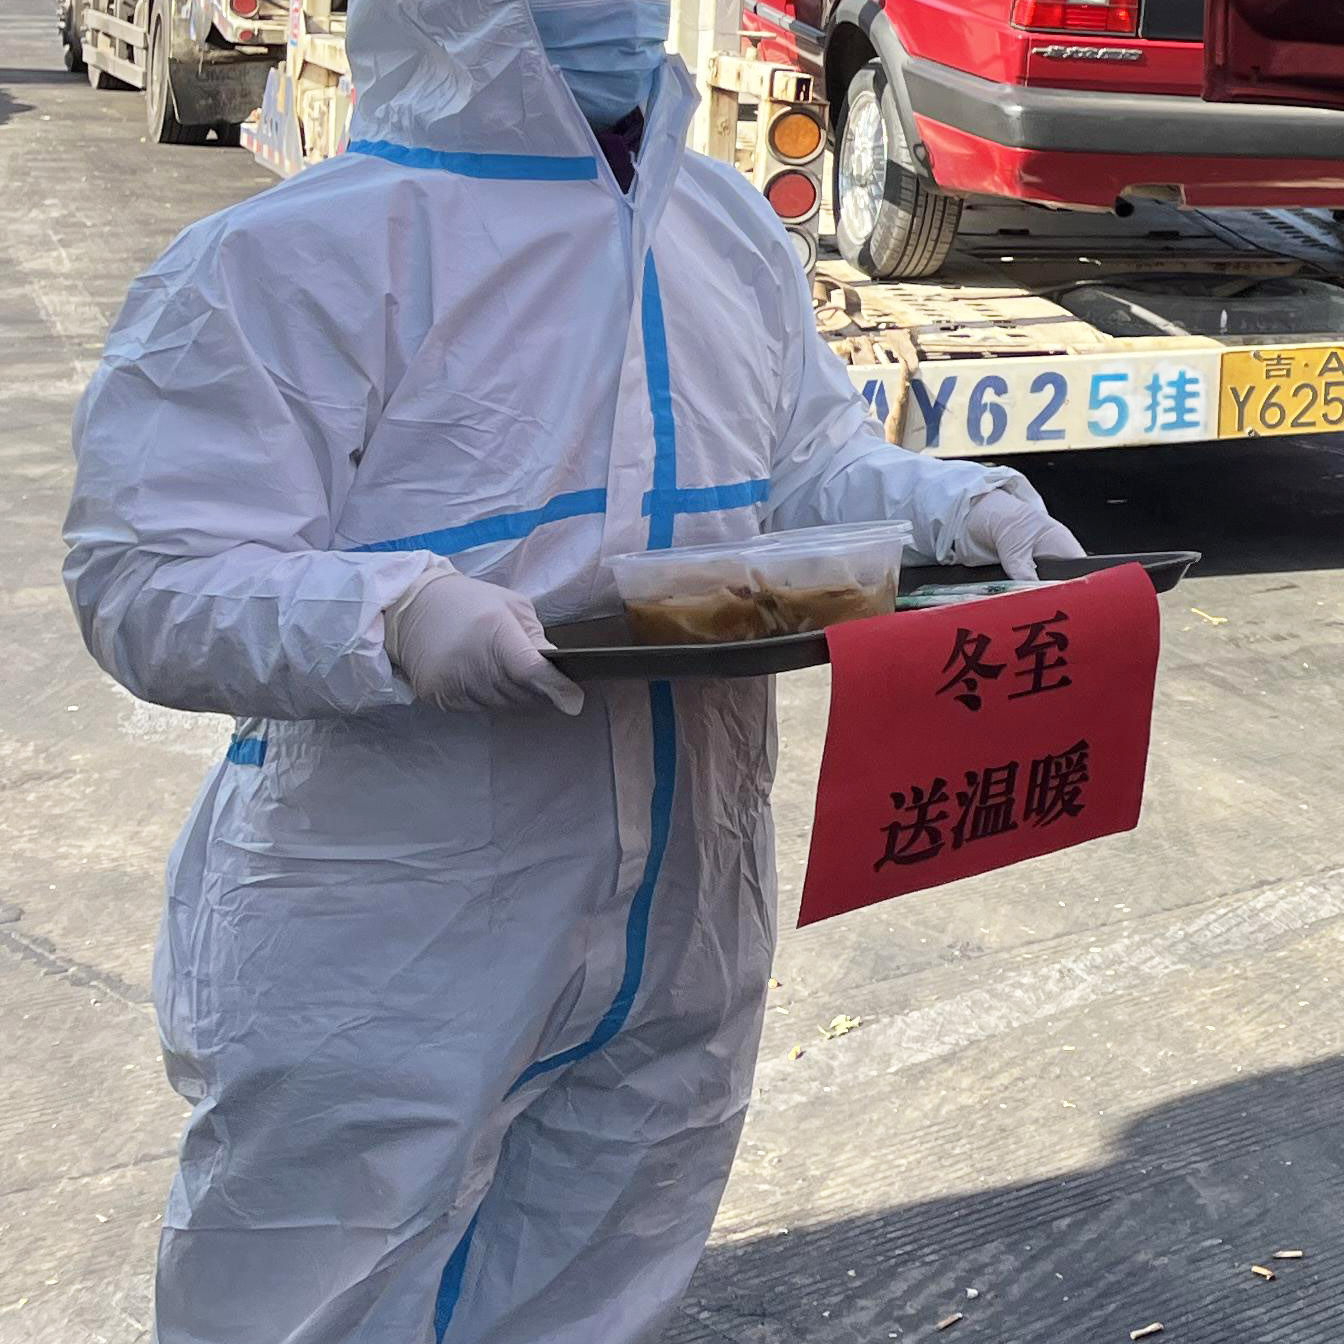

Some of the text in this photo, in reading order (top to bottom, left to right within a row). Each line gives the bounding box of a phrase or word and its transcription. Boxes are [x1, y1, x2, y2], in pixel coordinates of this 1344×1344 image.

[936, 610, 1073, 712] 冬至
[874, 739, 1091, 873] 送温暖
